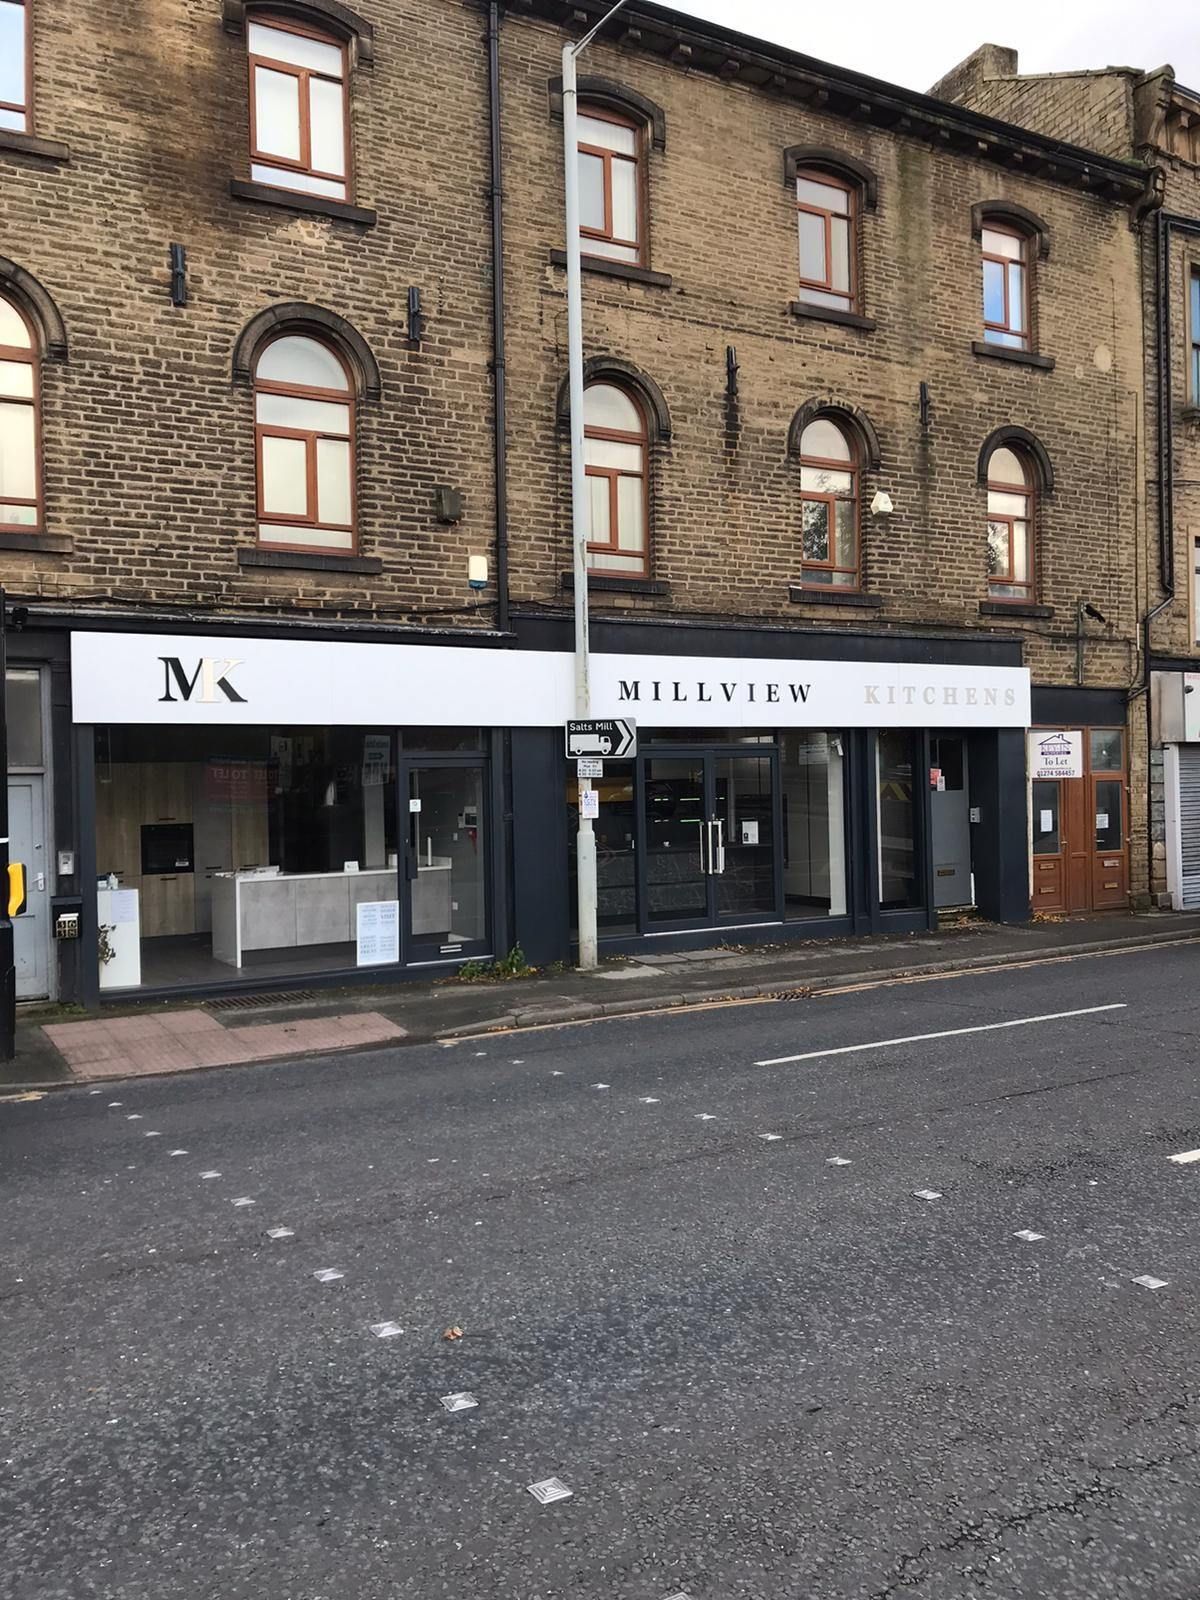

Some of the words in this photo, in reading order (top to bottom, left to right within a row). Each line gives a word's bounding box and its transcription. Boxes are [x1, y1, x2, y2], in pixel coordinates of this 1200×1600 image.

[157, 656, 249, 703] MK
[618, 680, 812, 703] MILLVIEW
[863, 685, 1016, 706] KITCHENS
[569, 722, 593, 731] Salts
[595, 722, 613, 731] Mill
[1043, 757, 1054, 765] To
[1055, 757, 1068, 765] Let
